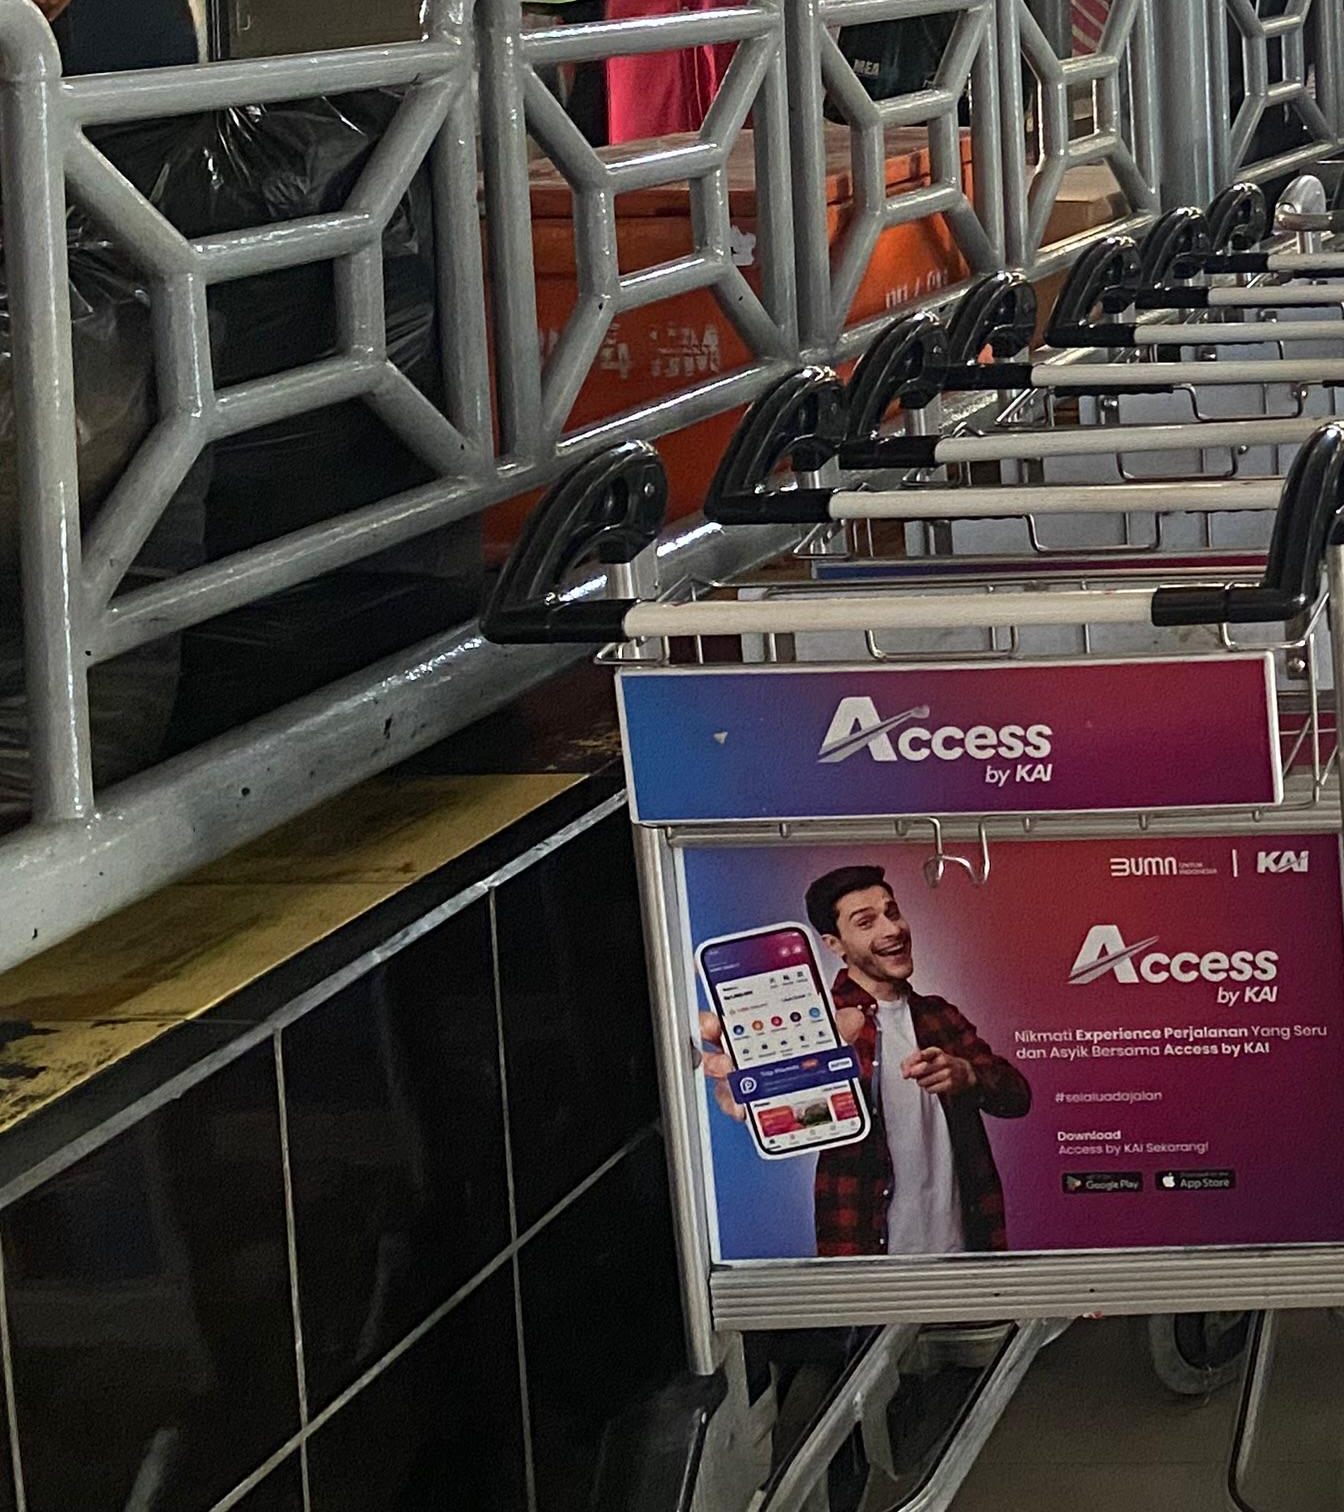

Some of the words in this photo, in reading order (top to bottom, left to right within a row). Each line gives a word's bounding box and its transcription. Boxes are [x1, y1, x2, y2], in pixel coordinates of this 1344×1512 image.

[817, 695, 1054, 763] Access
[985, 765, 1011, 787] by
[1016, 763, 1053, 782] KAI
[1257, 850, 1309, 873] KAI
[1068, 924, 1279, 984] Access
[1217, 987, 1239, 1007] by
[1244, 986, 1278, 1003] KAI
[1014, 1029, 1073, 1043] Nikmati
[1076, 1029, 1161, 1044] Experience
[1164, 1026, 1248, 1041] Perjalanan
[1251, 1025, 1290, 1039] Yang
[1294, 1024, 1327, 1036] Seru
[1016, 1047, 1047, 1059] dan
[1050, 1047, 1088, 1061] Asyik
[1091, 1044, 1160, 1058] Bersama
[1164, 1042, 1218, 1055] Access
[1221, 1042, 1241, 1057] by
[1244, 1041, 1270, 1054] KAI
[1055, 1089, 1162, 1104] #selaluadajalan
[1057, 1130, 1121, 1142] Download
[1058, 1144, 1103, 1155] Access
[1105, 1143, 1121, 1156] by
[1124, 1143, 1143, 1153] KAI
[1146, 1141, 1209, 1155] Sekarang!
[1085, 1179, 1119, 1192] Google
[1120, 1178, 1139, 1190] Play
[1180, 1178, 1202, 1189] App
[1202, 1177, 1230, 1188] Store
